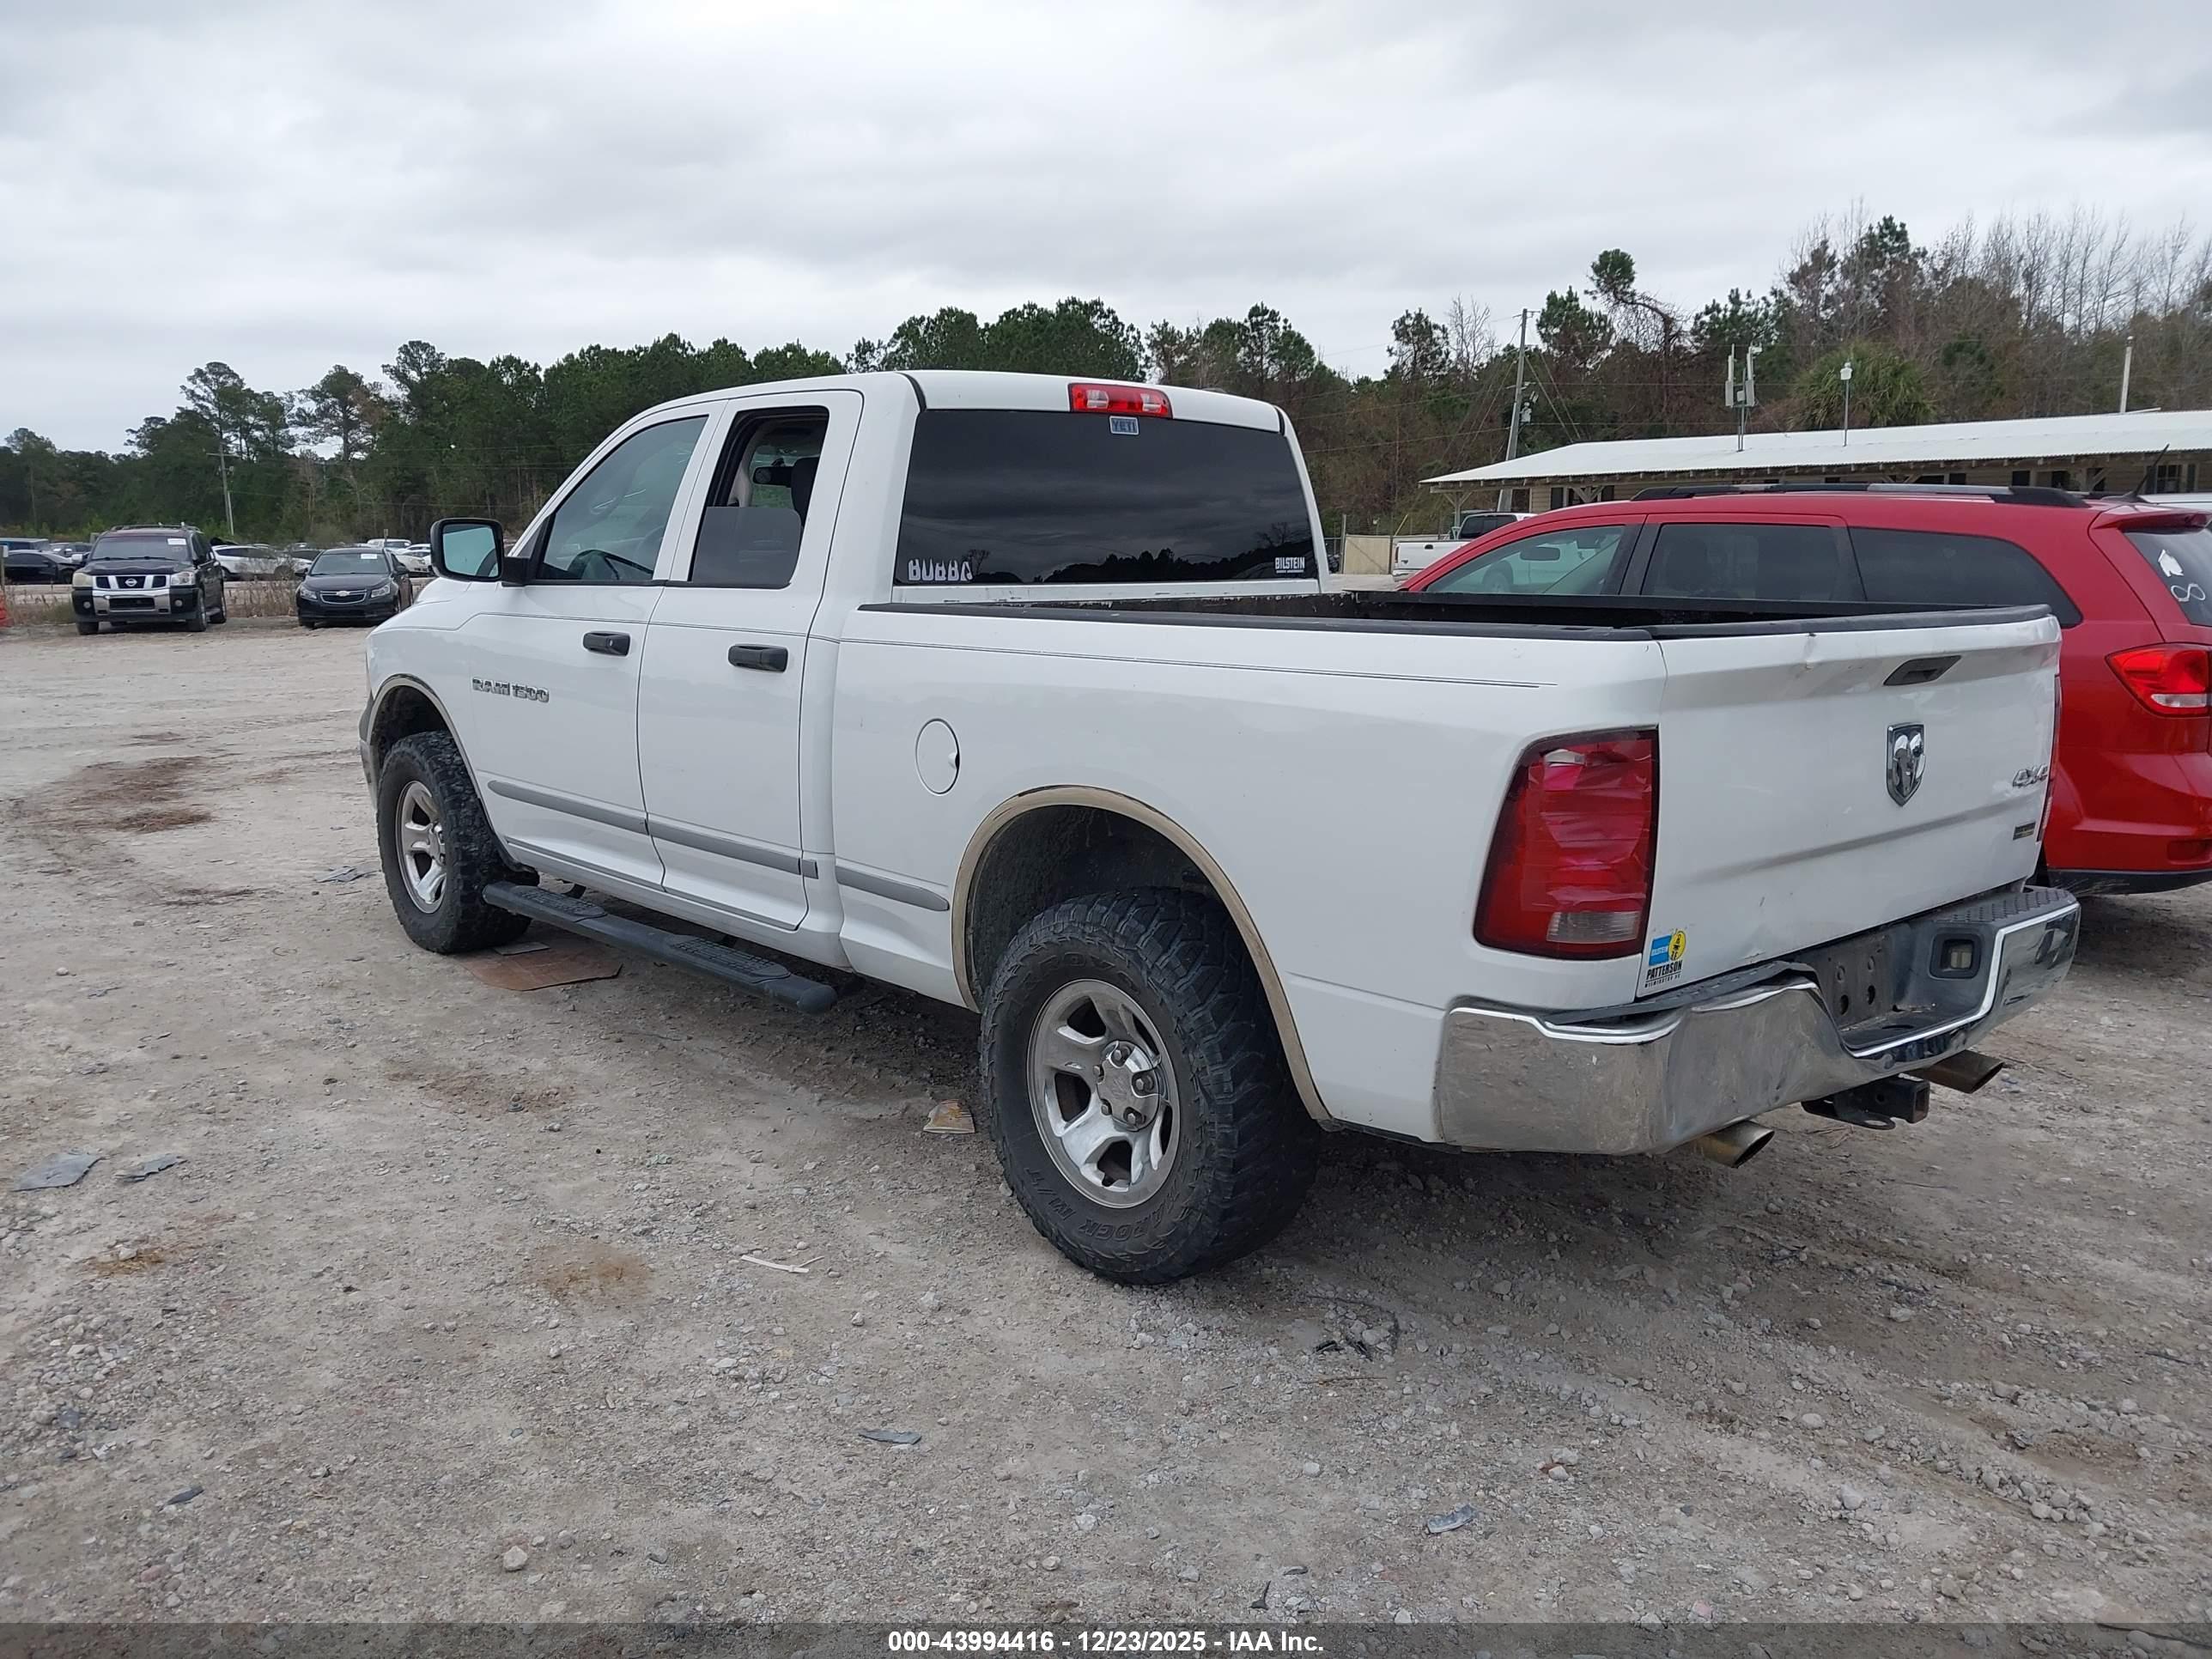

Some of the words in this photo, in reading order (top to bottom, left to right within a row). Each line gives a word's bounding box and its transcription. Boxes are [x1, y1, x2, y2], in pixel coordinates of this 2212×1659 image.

[908, 558, 973, 581] BUBBA
[1274, 556, 1305, 569] BILSTEIN
[471, 677, 511, 696] RAM
[511, 683, 550, 703] 1500
[1646, 960, 1683, 981] PATTERSON
